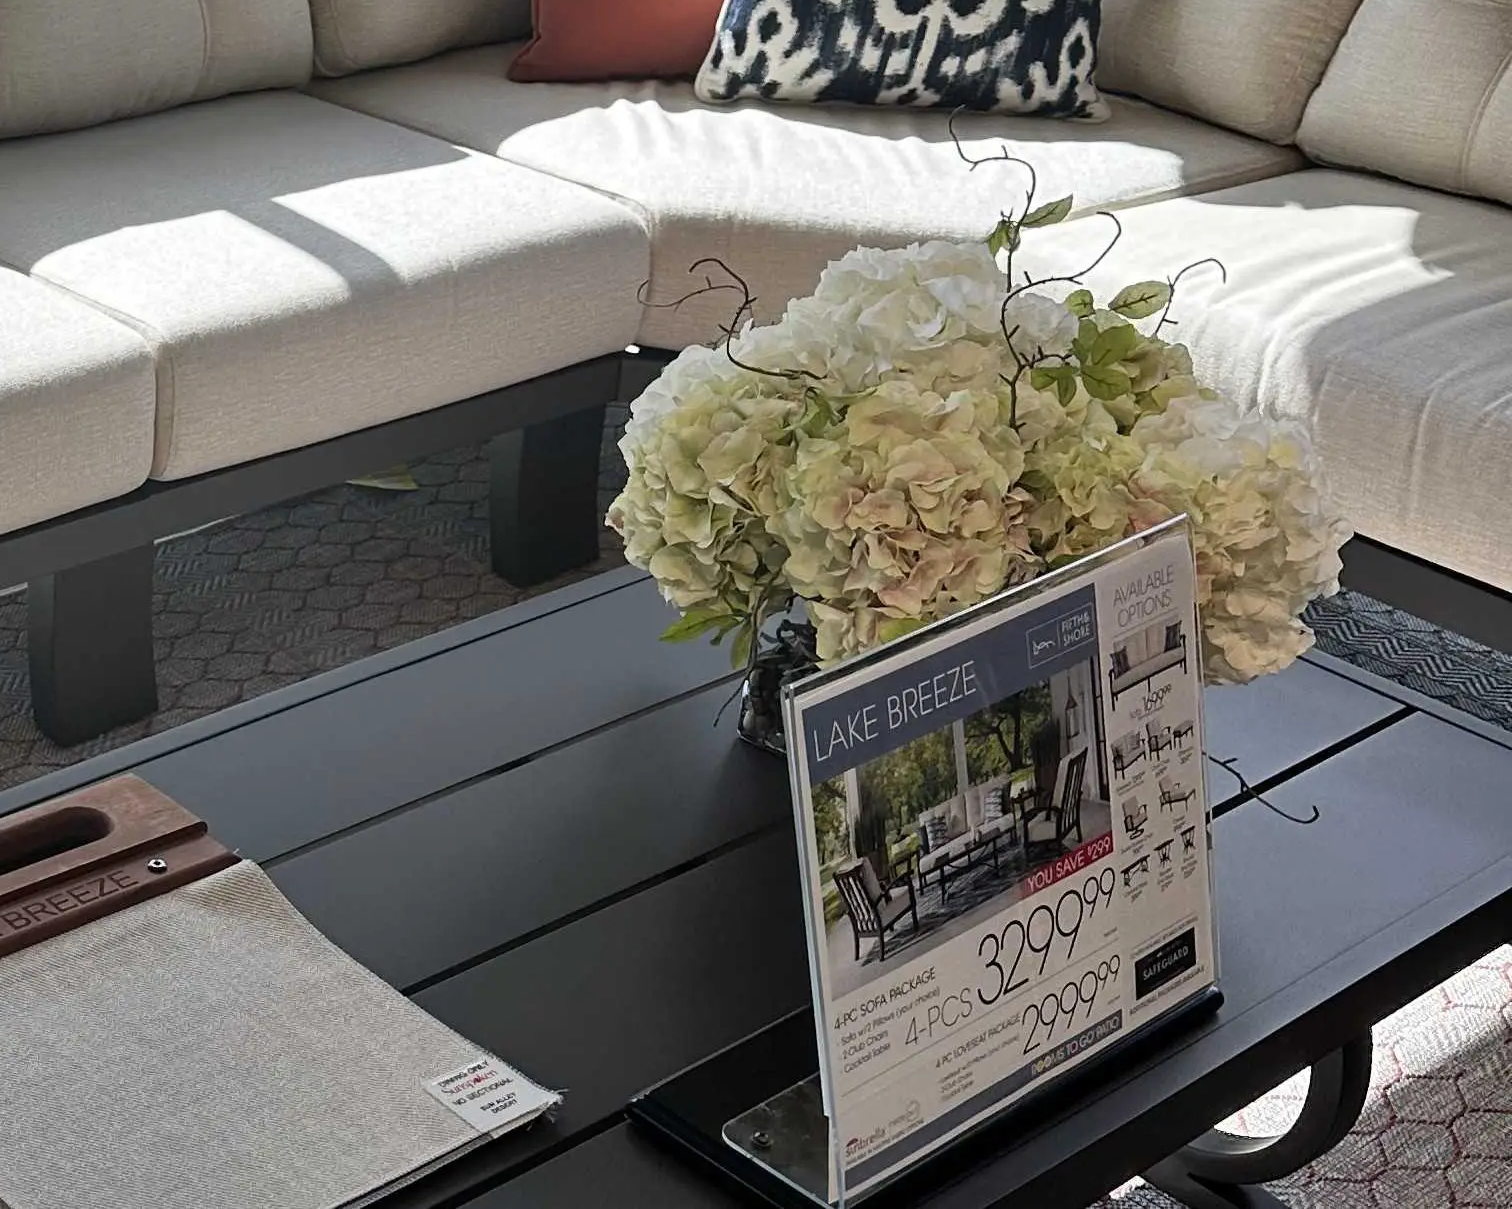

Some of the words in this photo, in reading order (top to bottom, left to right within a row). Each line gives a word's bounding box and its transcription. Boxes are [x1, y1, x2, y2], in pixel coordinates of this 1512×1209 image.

[1113, 565, 1174, 607] AVAILABLE
[1117, 589, 1172, 627] OPTIONS
[813, 704, 879, 762] LAKE
[887, 660, 977, 730] BREEZE
[1027, 868, 1054, 893] YOU
[1055, 849, 1085, 879] SAVE
[1087, 836, 1112, 863] $299
[0, 869, 138, 931] BREEZE
[1143, 945, 1189, 981] SAFEGUARD
[834, 1008, 858, 1030] 4-PC
[860, 994, 887, 1017] SOFA
[889, 966, 937, 1002] PACKAGE
[905, 987, 974, 1045] 4-PCS
[1066, 1040, 1078, 1056] TO
[1079, 1031, 1095, 1048] GO
[467, 1059, 489, 1074] ONLY
[466, 1077, 514, 1101] SECTIONAL
